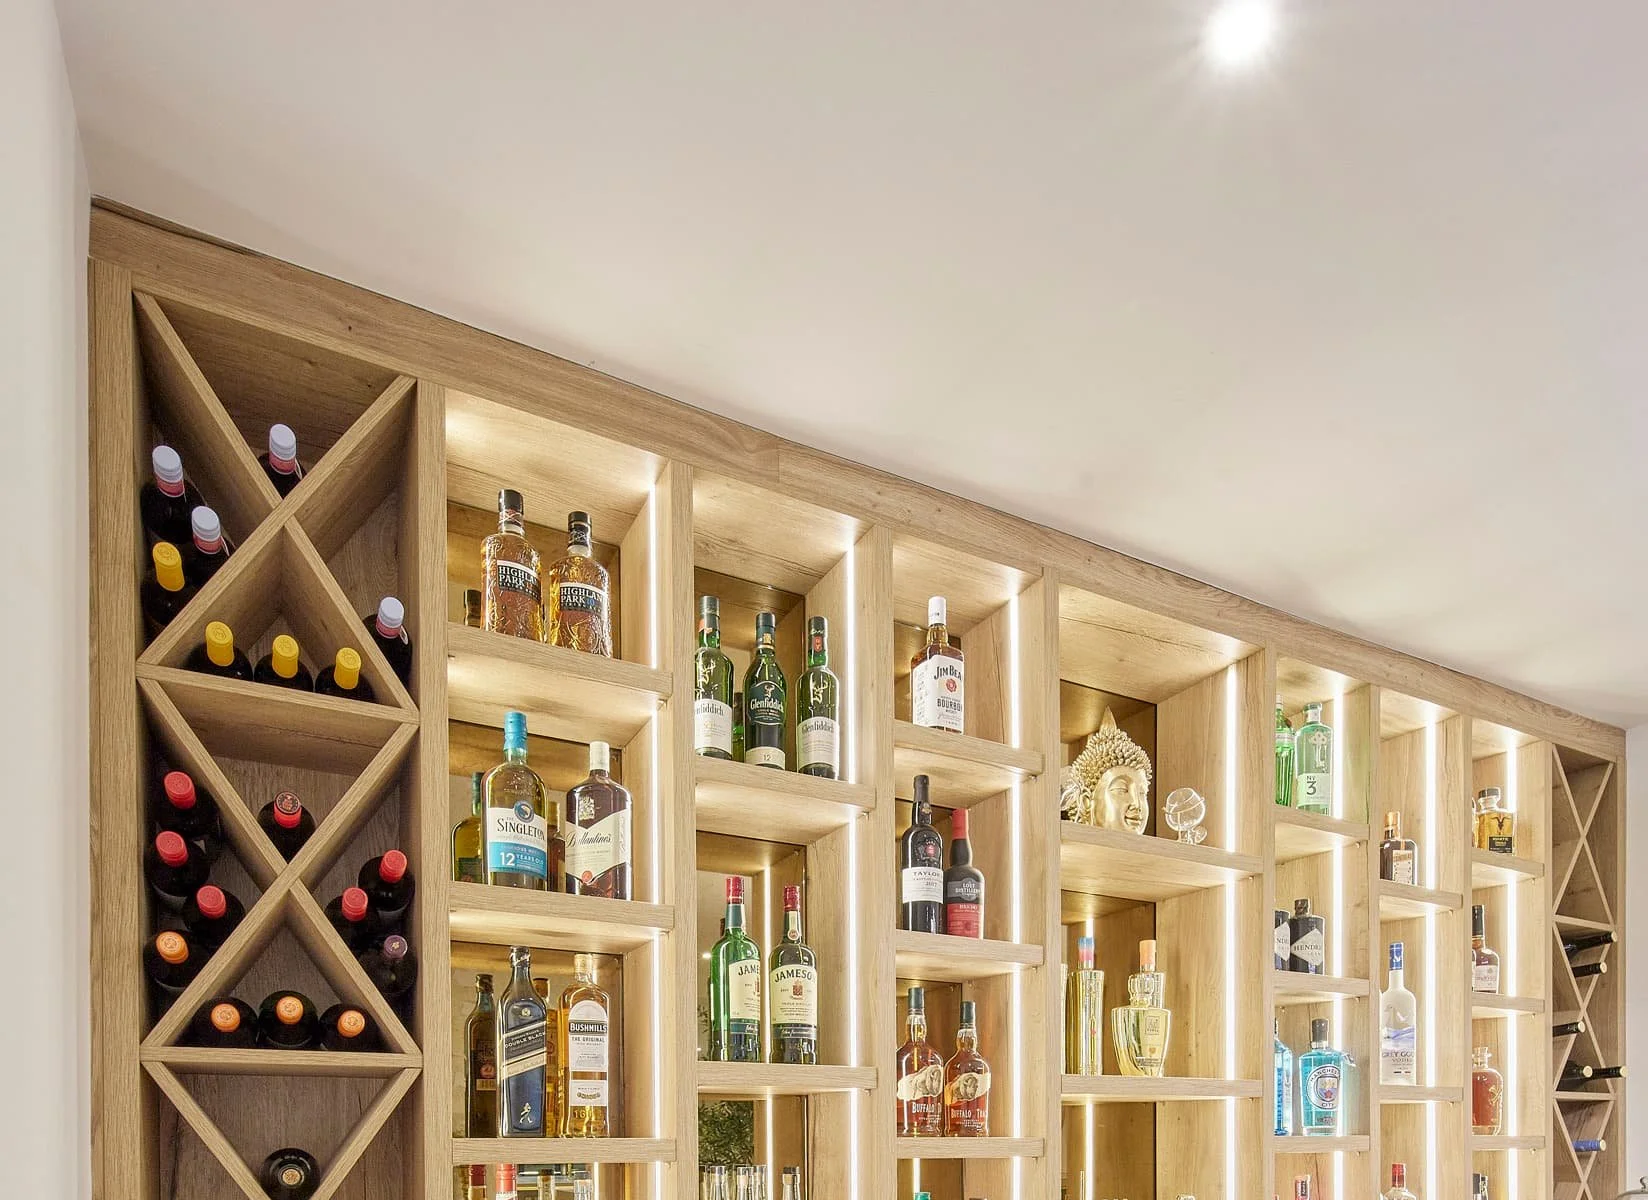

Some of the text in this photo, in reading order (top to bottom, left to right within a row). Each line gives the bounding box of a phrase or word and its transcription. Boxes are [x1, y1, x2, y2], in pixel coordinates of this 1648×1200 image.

[499, 574, 525, 587] PARK
[561, 595, 585, 603] PARK
[934, 665, 949, 680] JIM
[750, 698, 784, 713] Glenfiddich
[1307, 781, 1317, 796] 3
[500, 852, 515, 867] 12
[569, 1022, 608, 1034] BUSHMILLS
[505, 1037, 527, 1049] DOUBLE
[912, 1102, 935, 1113] BUFFALO
[951, 1109, 972, 1118] BUFFALO
